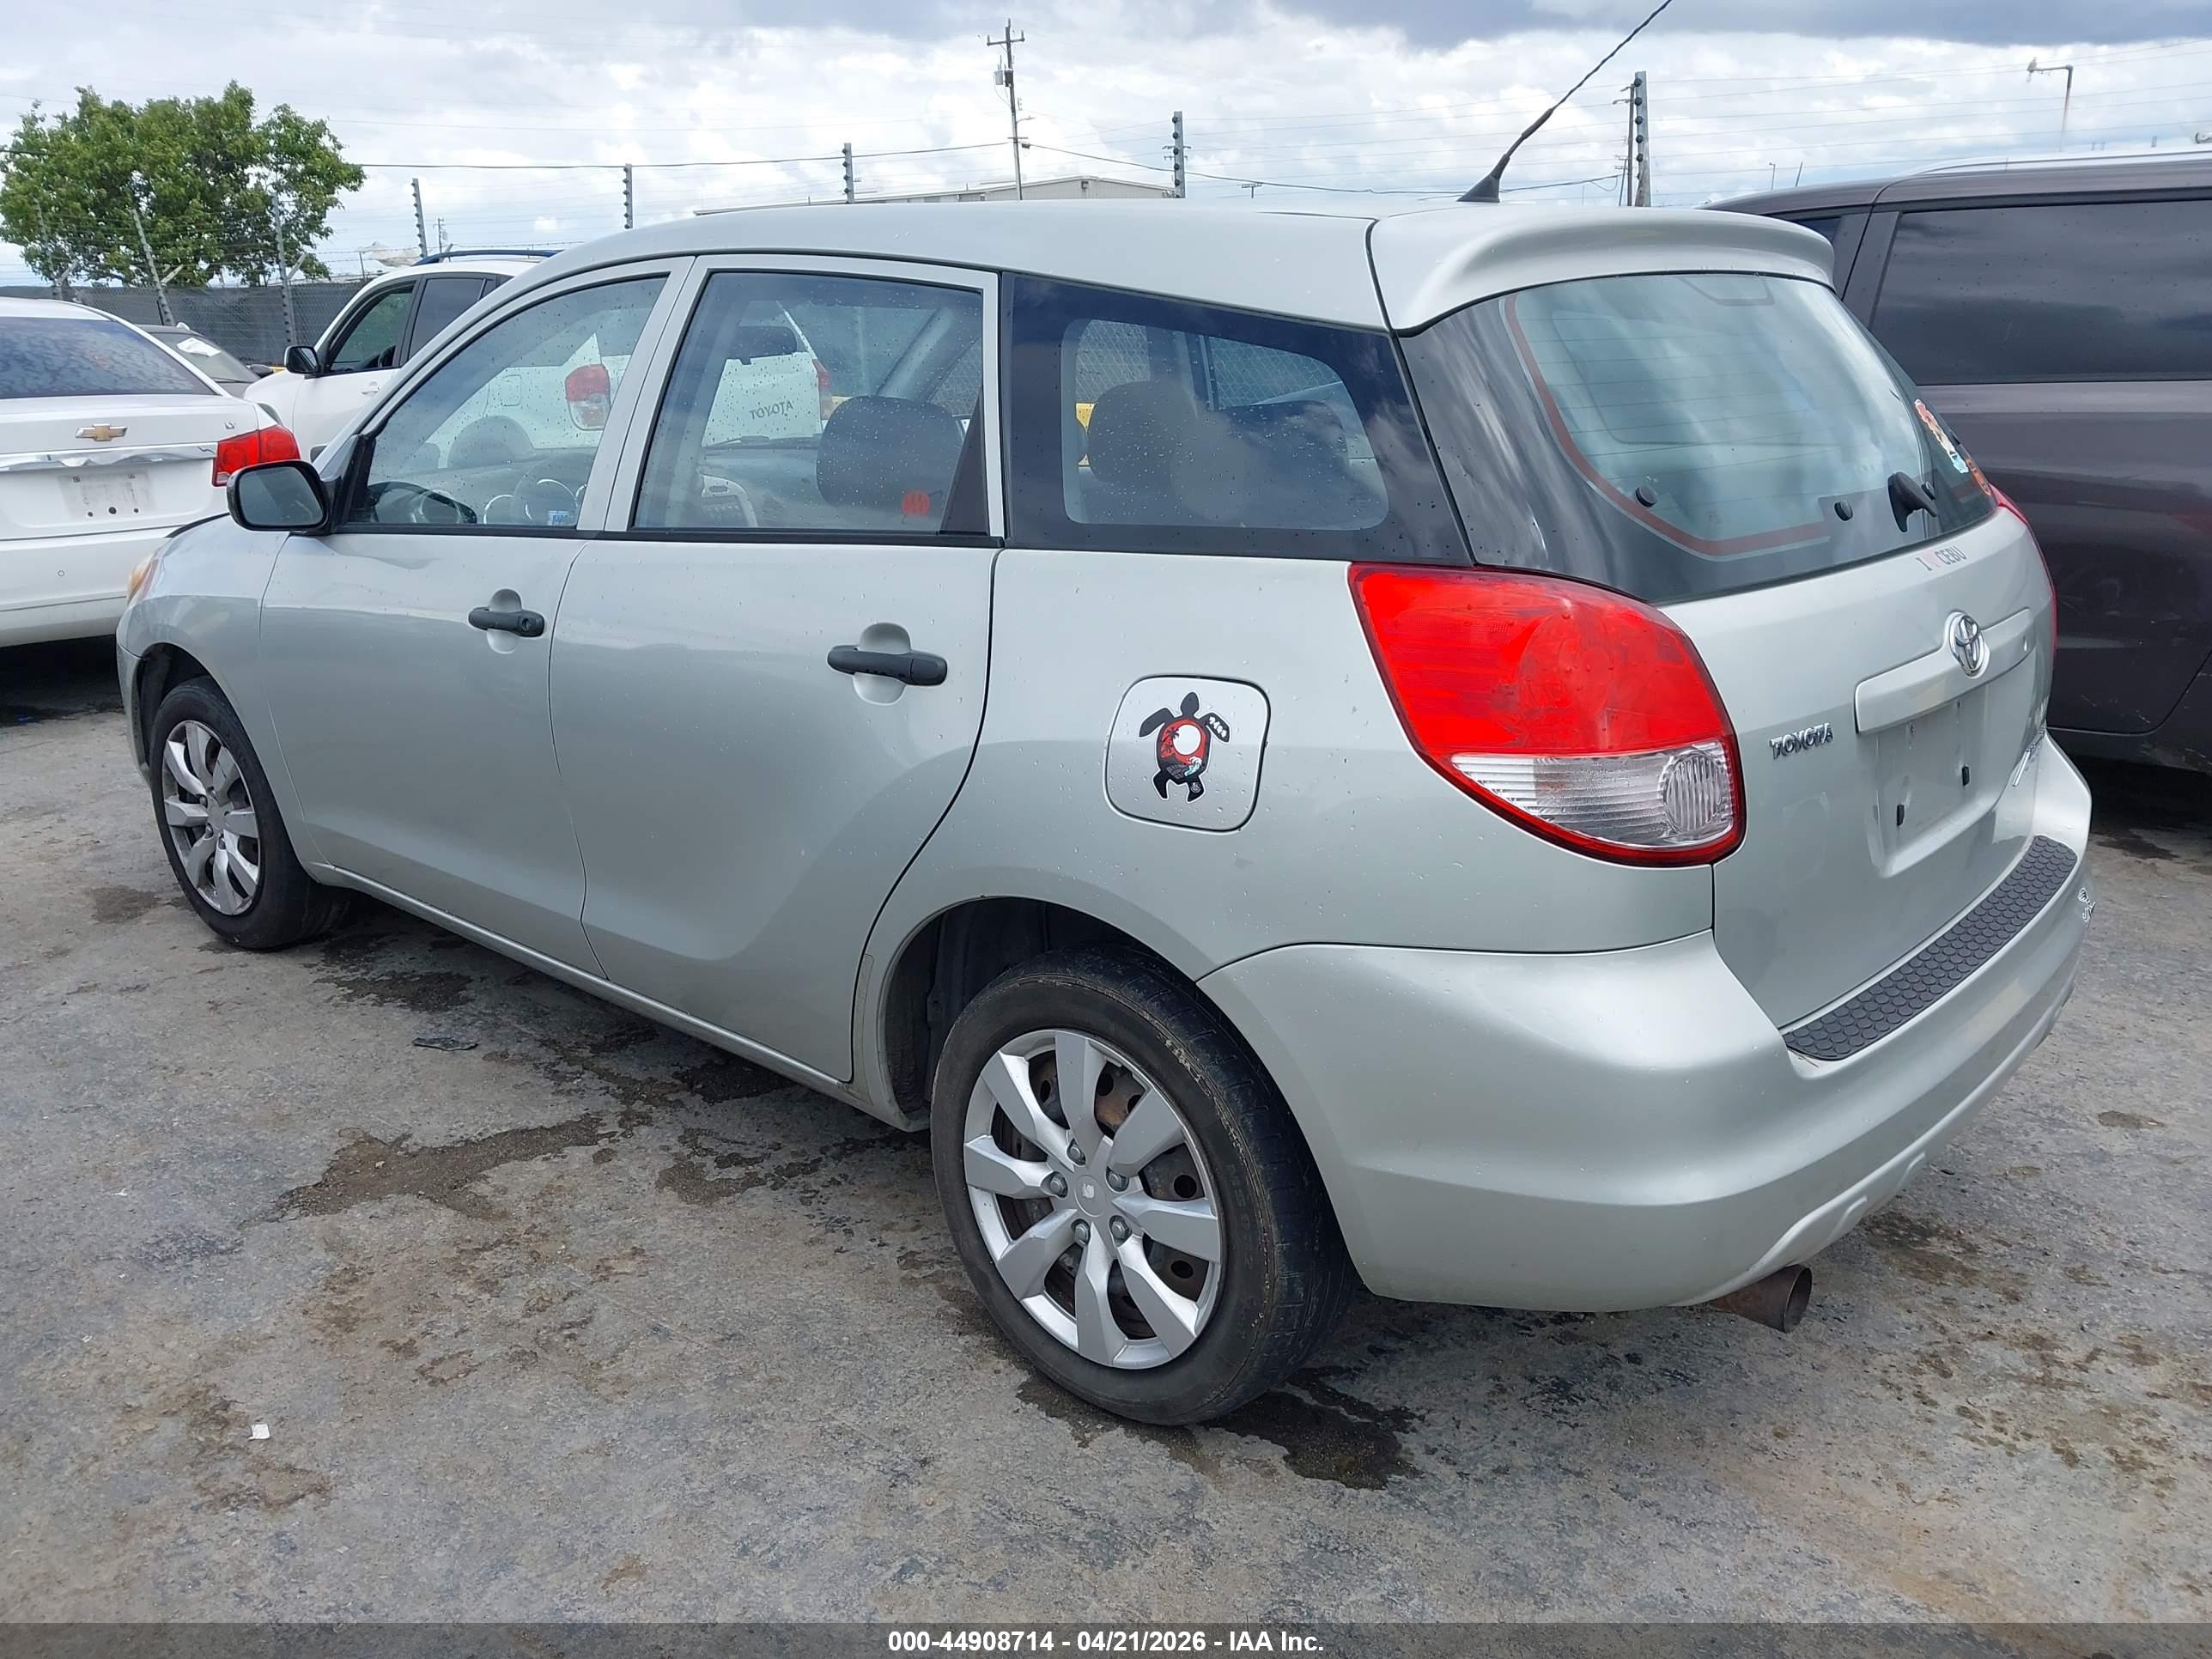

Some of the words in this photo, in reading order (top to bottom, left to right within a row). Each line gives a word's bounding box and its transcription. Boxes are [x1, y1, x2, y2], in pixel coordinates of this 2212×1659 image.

[749, 400, 793, 420] TOYOTA
[1935, 545, 1967, 565] CEBU
[1769, 722, 1834, 760] TOYOTA
